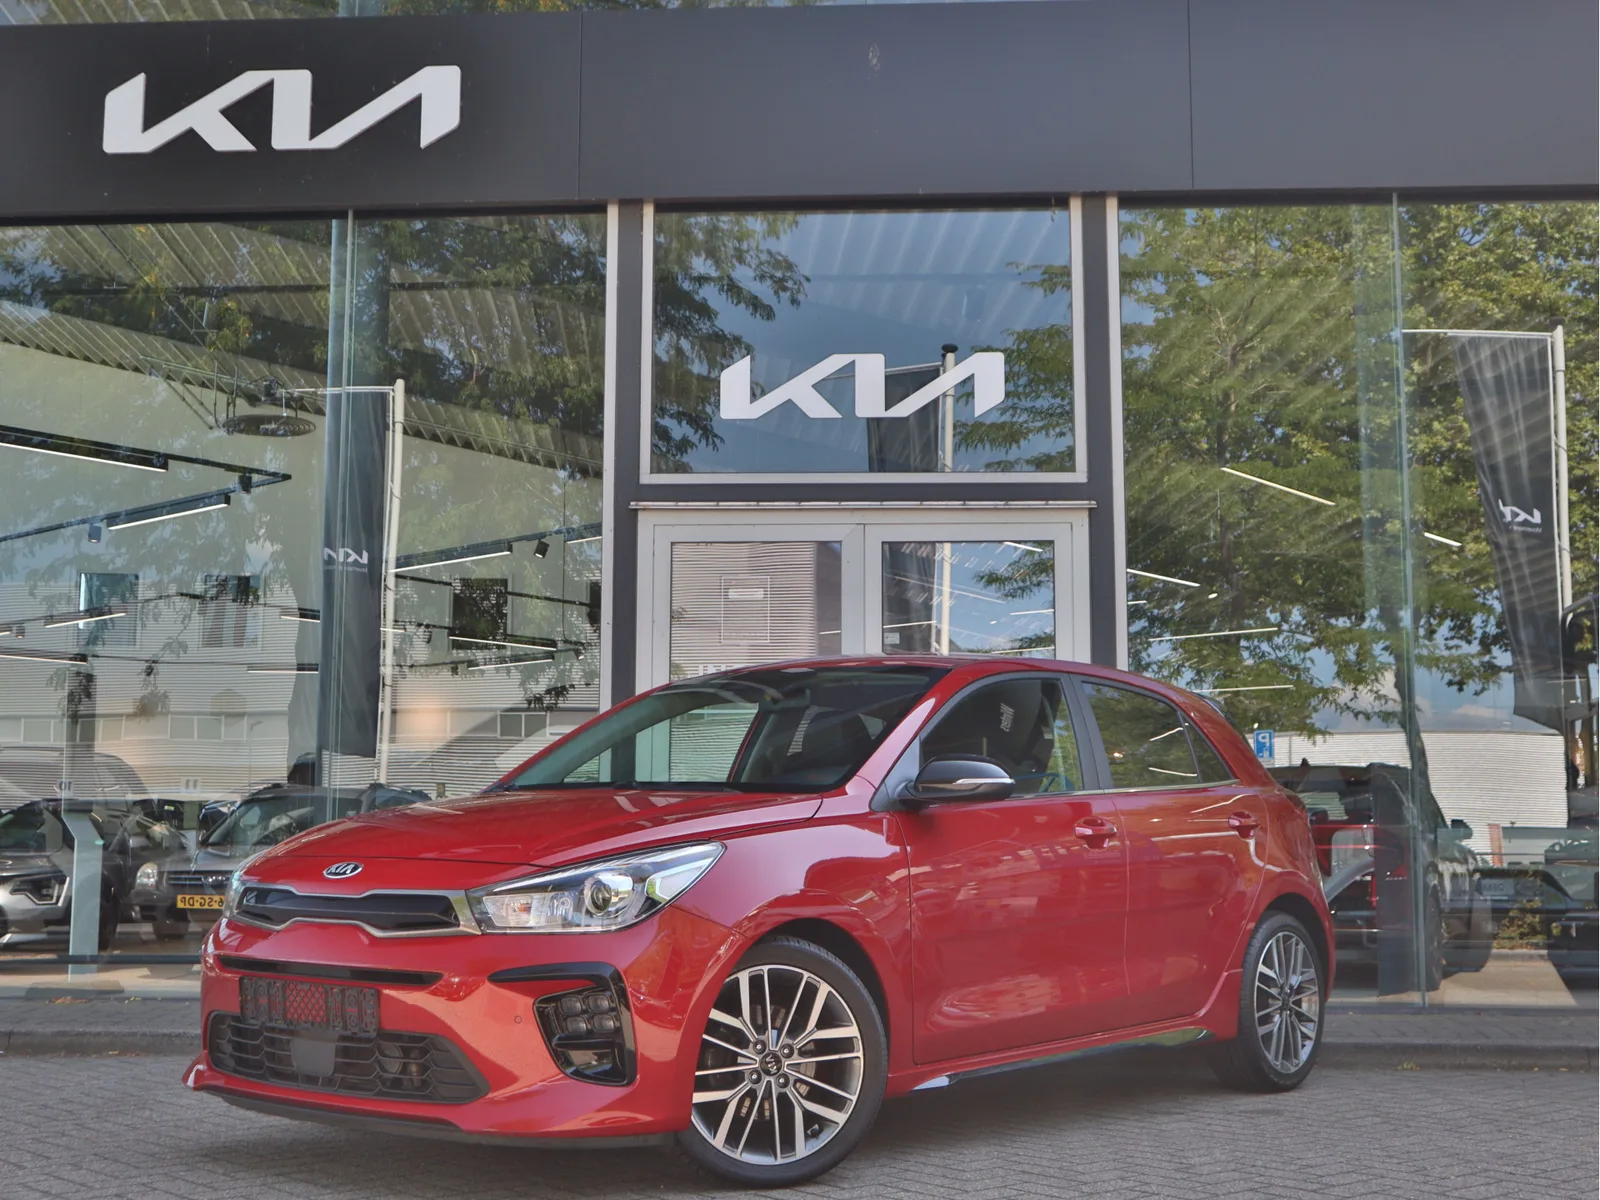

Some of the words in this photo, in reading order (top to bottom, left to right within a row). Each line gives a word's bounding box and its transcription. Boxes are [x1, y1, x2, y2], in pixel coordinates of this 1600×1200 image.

[102, 65, 461, 154] KIA
[720, 352, 1005, 420] KIA
[328, 863, 355, 874] KIA
